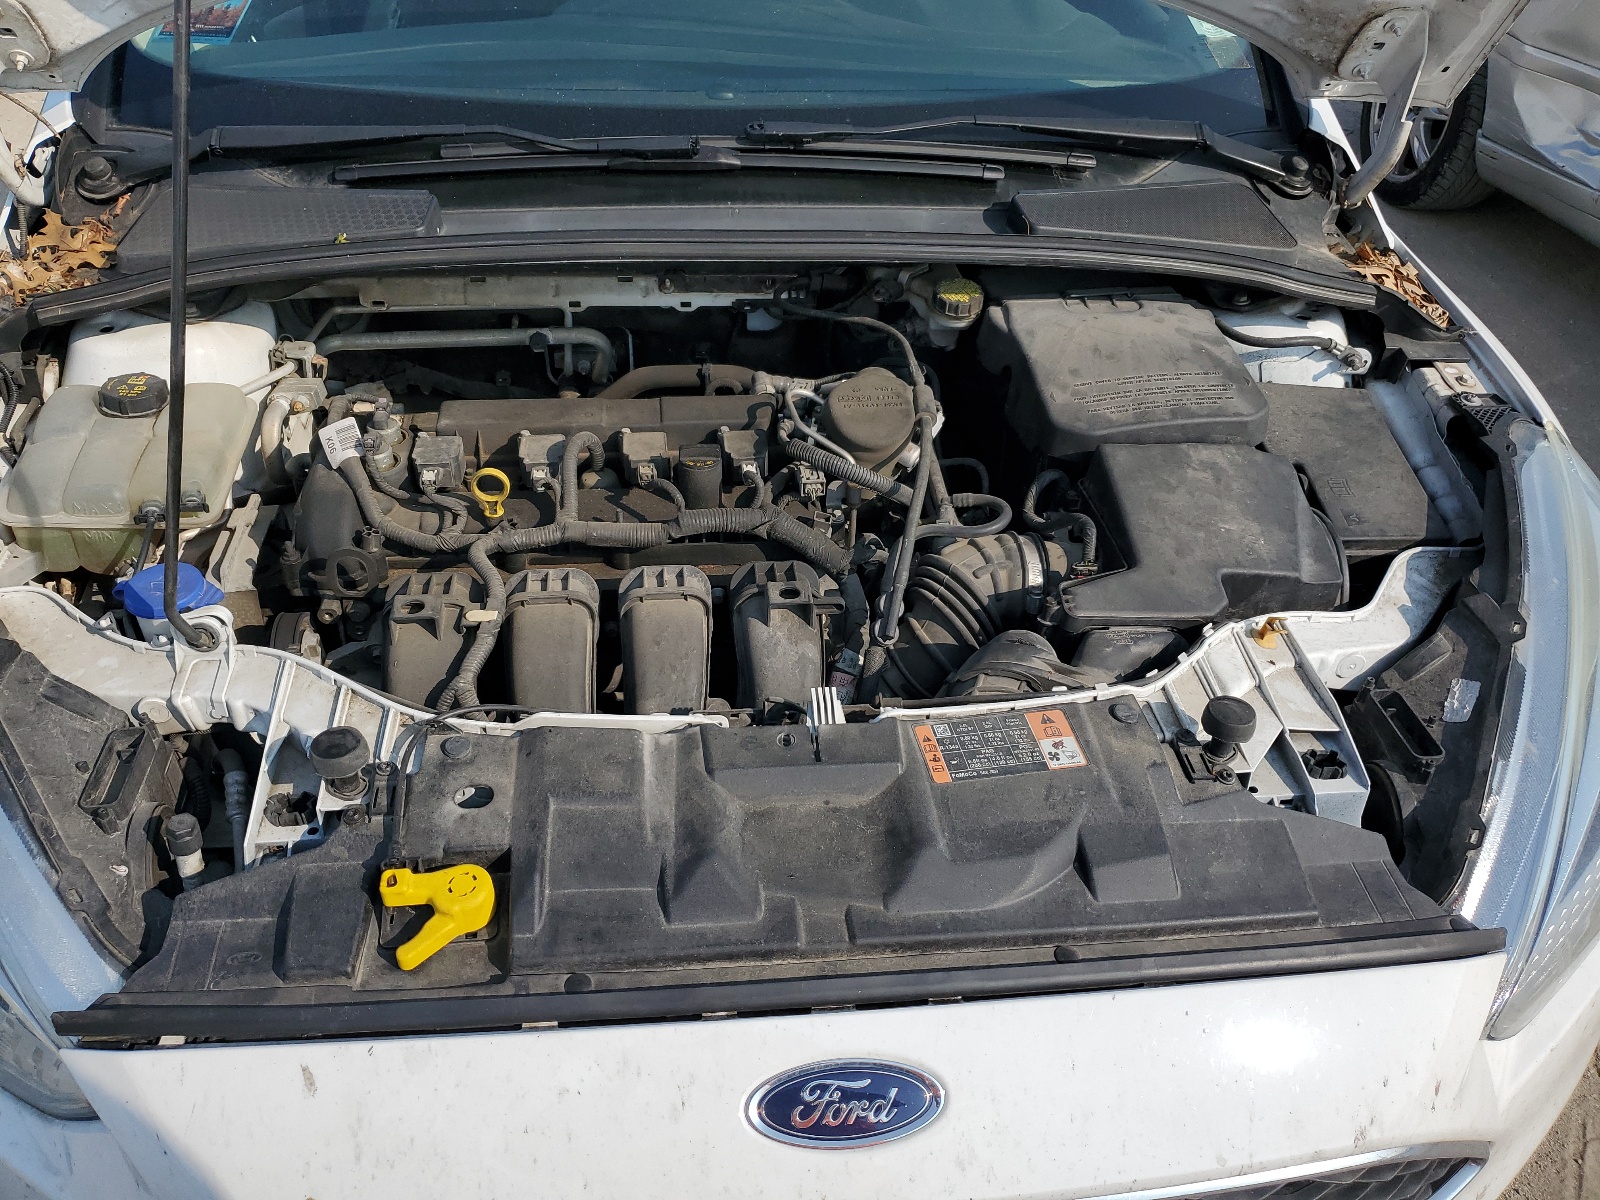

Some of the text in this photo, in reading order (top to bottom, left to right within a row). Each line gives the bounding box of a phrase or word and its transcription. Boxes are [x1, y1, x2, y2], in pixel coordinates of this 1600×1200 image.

[324, 436, 337, 455] K06
[82, 530, 116, 543] MIN
[790, 1078, 899, 1129] Ford
